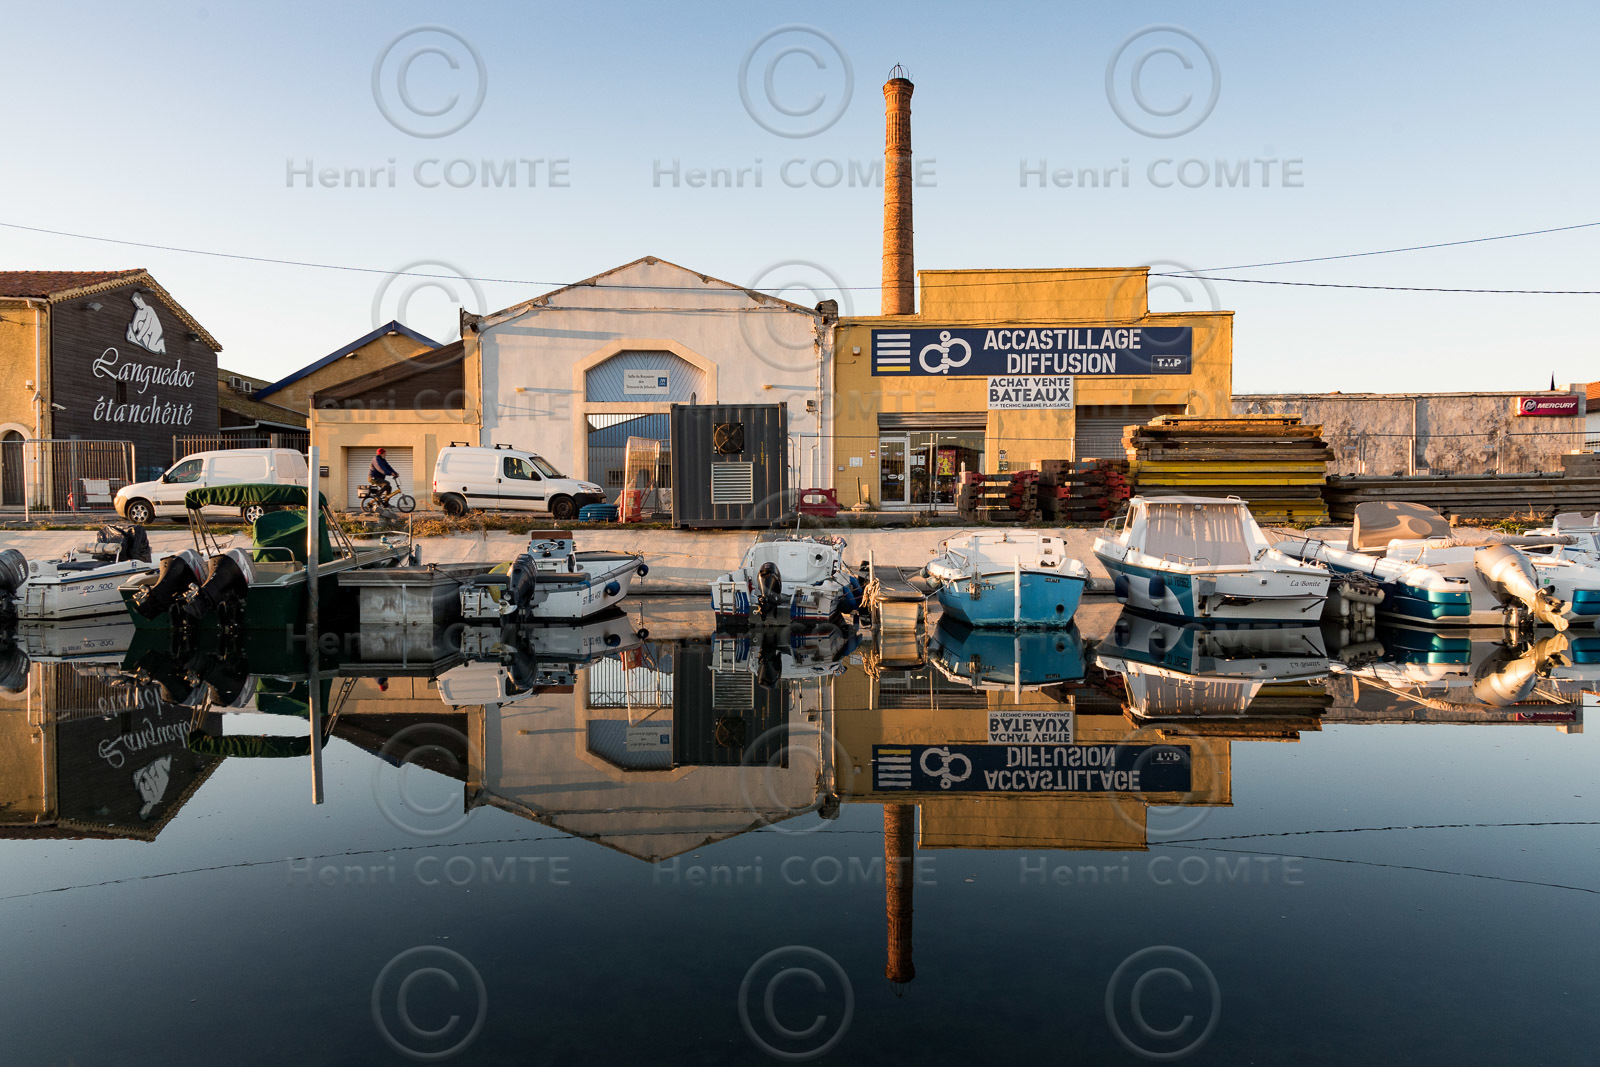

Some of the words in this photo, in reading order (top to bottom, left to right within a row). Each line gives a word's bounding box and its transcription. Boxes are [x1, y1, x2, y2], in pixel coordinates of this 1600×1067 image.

[983, 329, 1142, 350] ACCASTILLAGE
[93, 347, 195, 394] Languedoc
[1007, 352, 1116, 373] DIFFUSION
[990, 379, 1029, 387] ACHAT
[1033, 378, 1071, 387] VENTE
[990, 388, 1070, 402] BATEAUX
[93, 395, 193, 426] étanchéité
[1290, 579, 1299, 587] La
